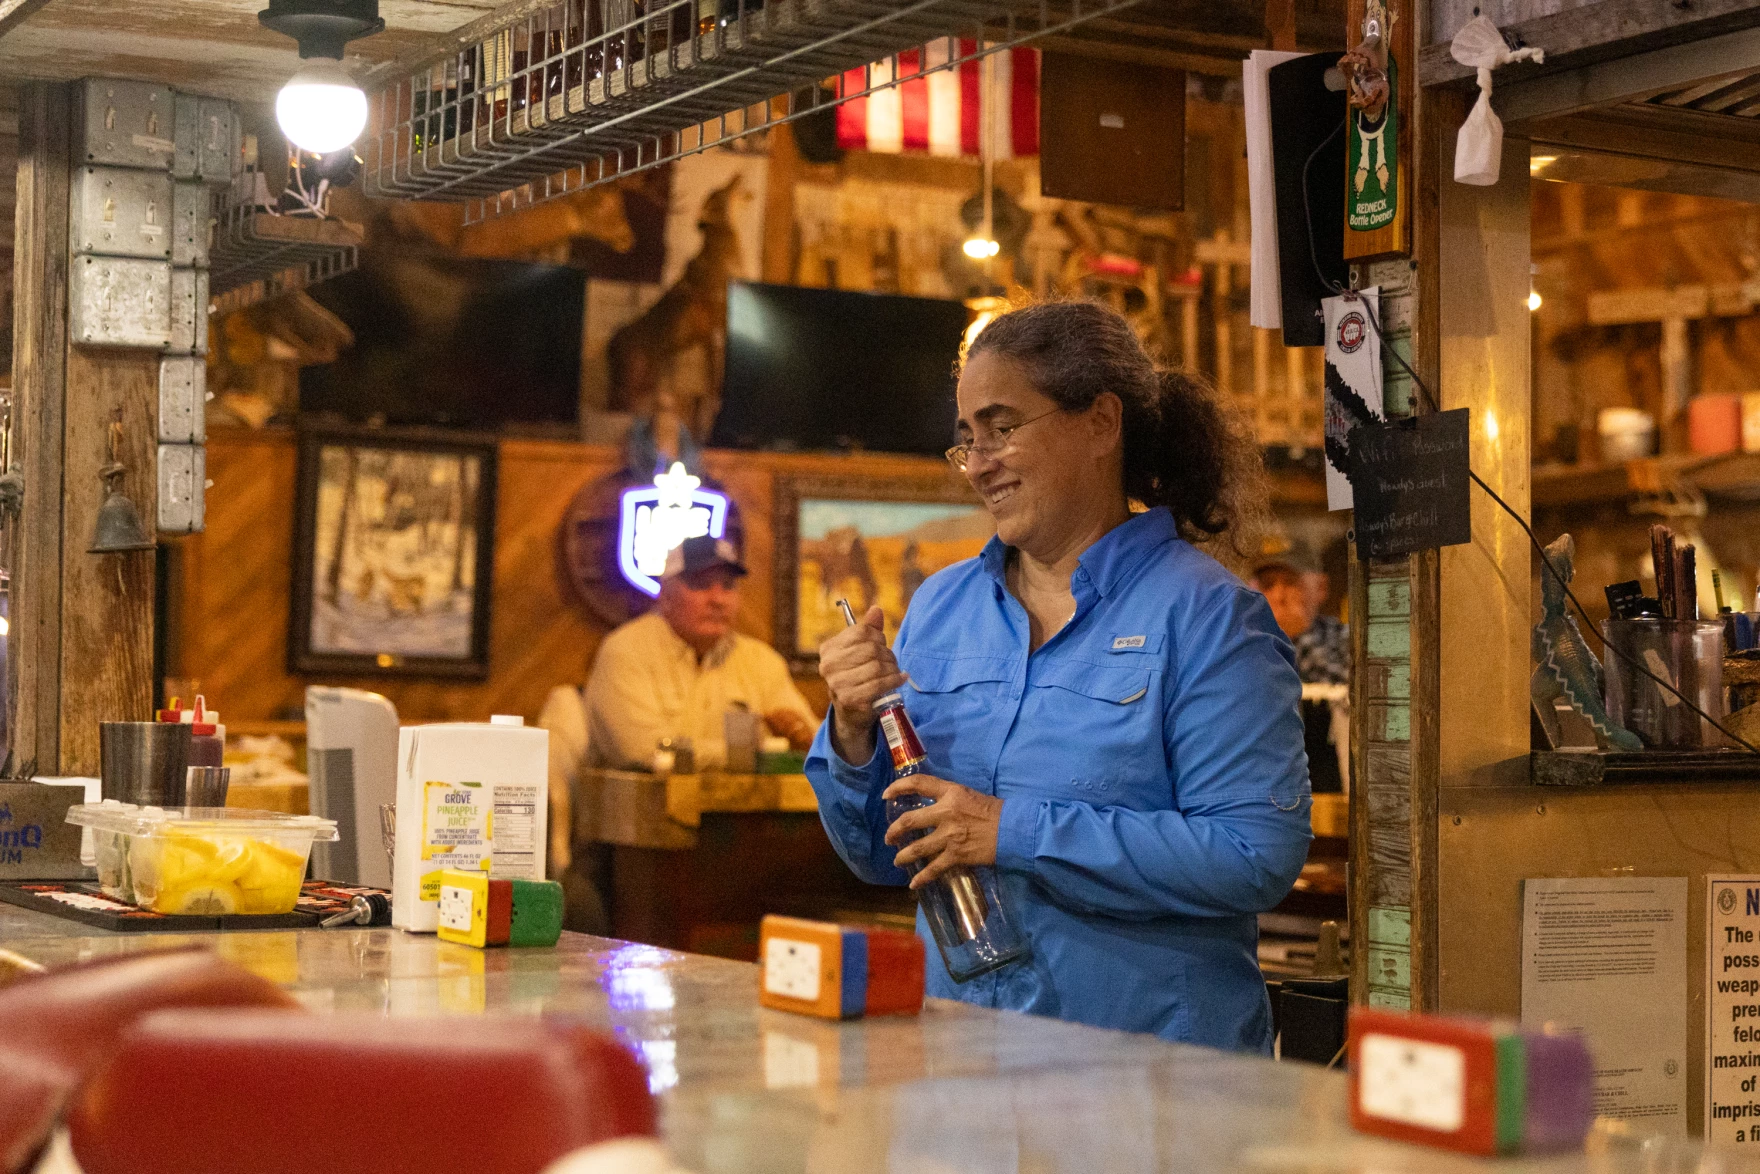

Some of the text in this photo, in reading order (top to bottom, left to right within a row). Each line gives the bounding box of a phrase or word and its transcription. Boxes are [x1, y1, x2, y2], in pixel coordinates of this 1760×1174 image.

[1356, 199, 1387, 214] REDNECK
[1349, 210, 1393, 226] Bottle Opener
[445, 794, 472, 804] GROVE
[437, 806, 479, 816] PINEAPPLE
[448, 817, 468, 827] JUICE
[0, 824, 42, 849] nQ
[1724, 926, 1754, 943] The
[1723, 954, 1760, 972] poss
[1717, 980, 1760, 996] weap
[1732, 1004, 1760, 1021] pre
[1741, 1075, 1757, 1092] of
[1735, 1129, 1745, 1143] a
